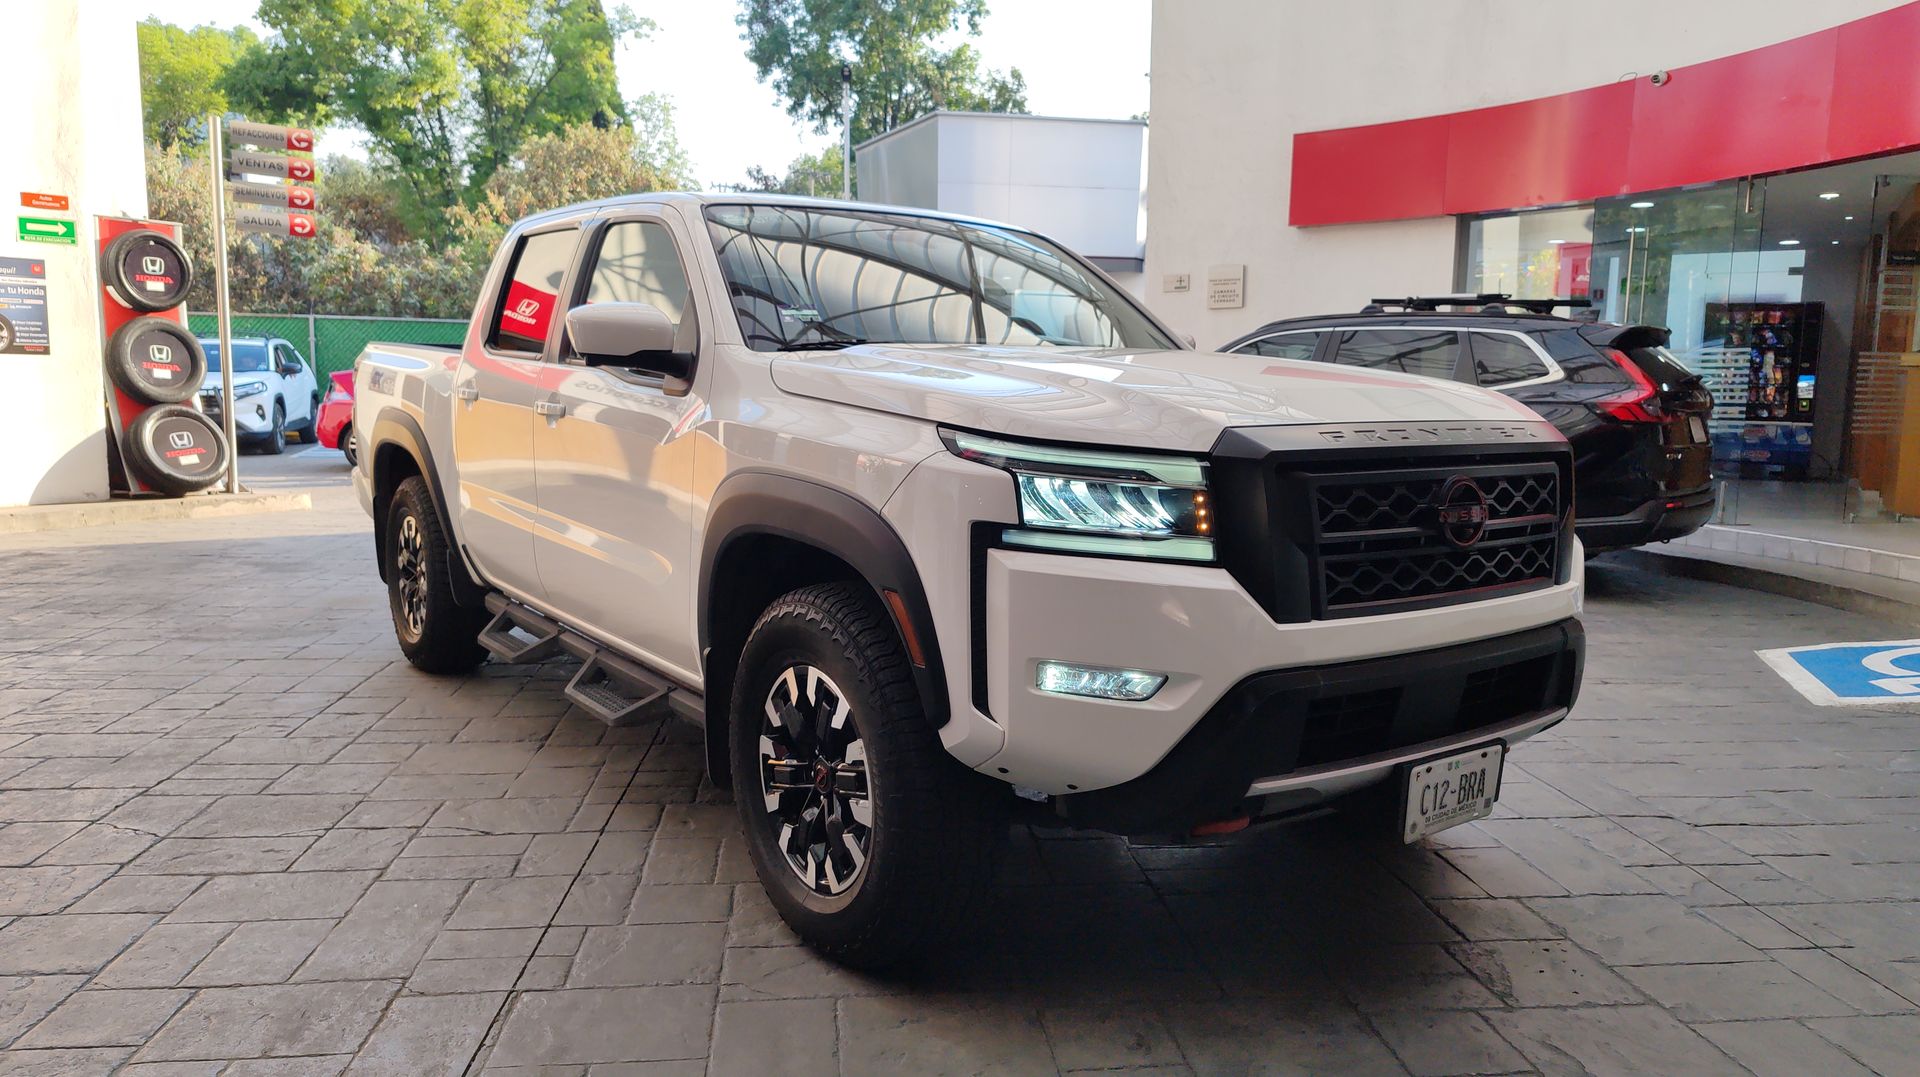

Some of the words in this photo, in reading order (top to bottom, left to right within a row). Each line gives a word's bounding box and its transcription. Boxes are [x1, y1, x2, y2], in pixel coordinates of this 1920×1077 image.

[232, 128, 285, 142] REFACCIONES
[238, 158, 284, 171] VENTAS
[235, 188, 287, 200] SEMINUEVOS
[243, 216, 282, 227] SALIDA
[135, 274, 174, 284] HONDA
[8, 286, 16, 294] tu
[17, 286, 44, 295] Honda
[142, 361, 182, 372] HONDA
[1318, 427, 1538, 442] FRONTIER
[165, 447, 207, 458] HONDA
[1421, 767, 1487, 815] C12-BRA
[1431, 809, 1451, 820] CIUDAD
